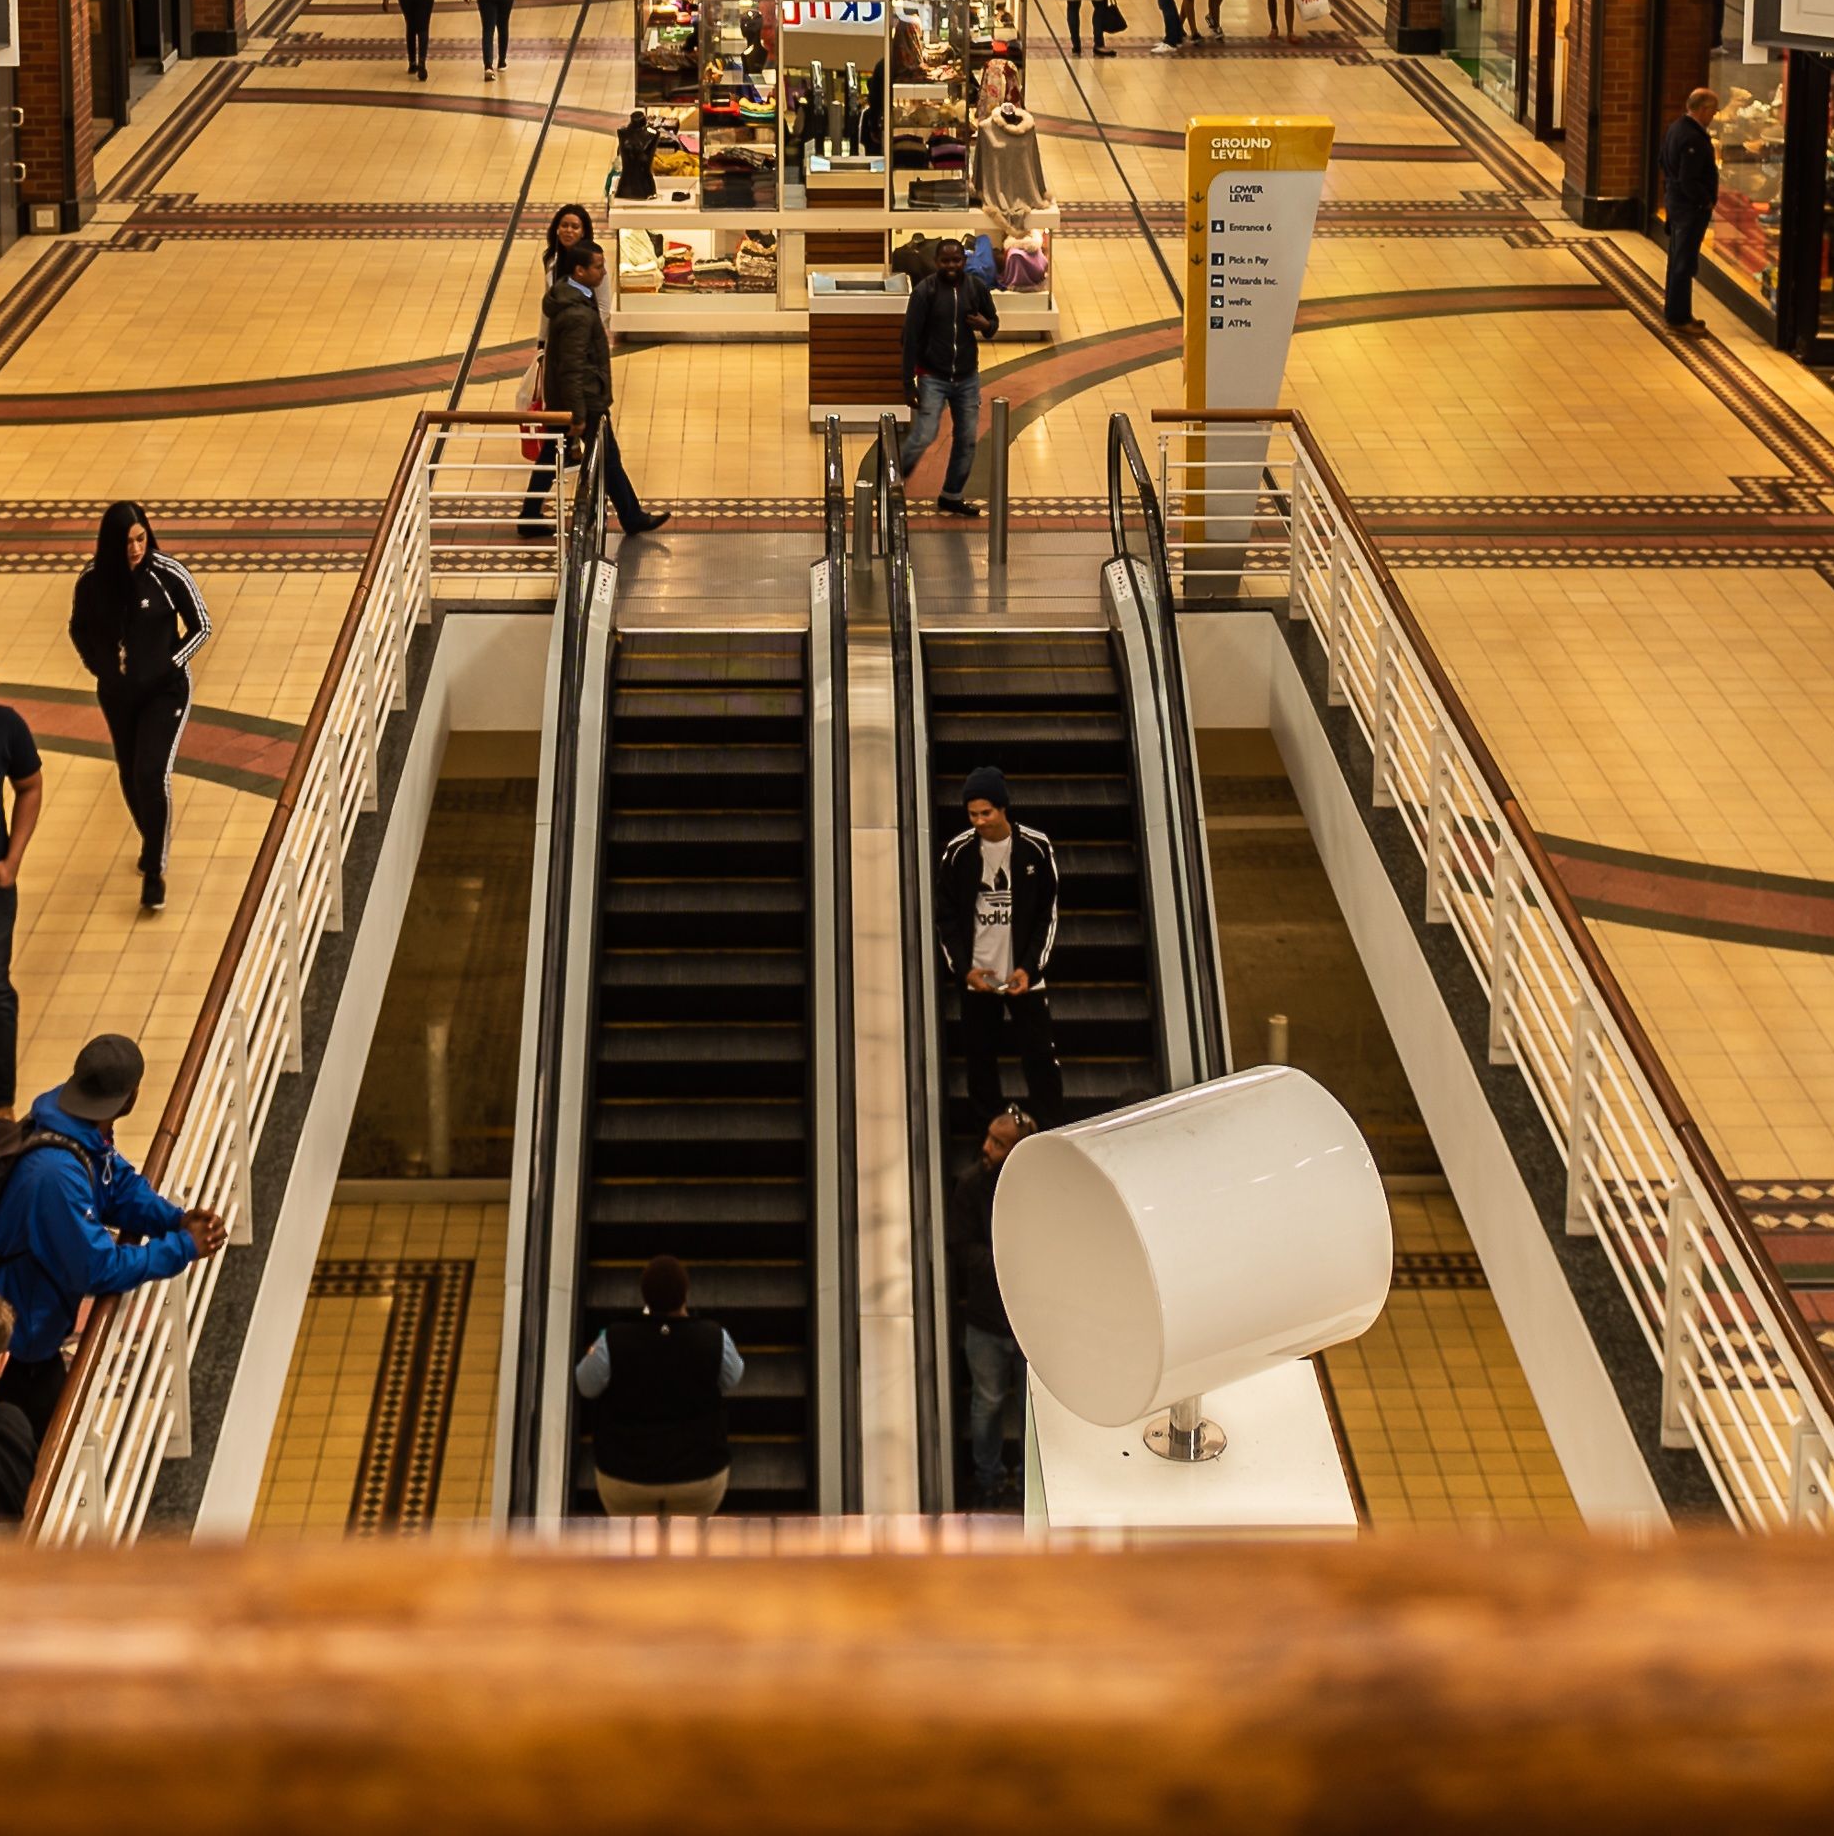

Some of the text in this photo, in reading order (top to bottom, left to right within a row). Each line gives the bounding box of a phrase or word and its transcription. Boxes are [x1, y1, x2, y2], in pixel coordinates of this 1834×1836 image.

[1211, 138, 1271, 149] GROUND
[1211, 150, 1251, 160] LEVEL
[1229, 185, 1263, 194] LOWER
[1229, 194, 1255, 203] LEVEL
[1229, 223, 1272, 232] Entrance 6
[1229, 256, 1246, 264] Pick
[1255, 256, 1269, 266] Pay
[1228, 277, 1278, 285] Wizards Inc.
[1228, 297, 1252, 306] weFix
[1228, 319, 1251, 328] ATMs
[978, 910, 1012, 925] adid
